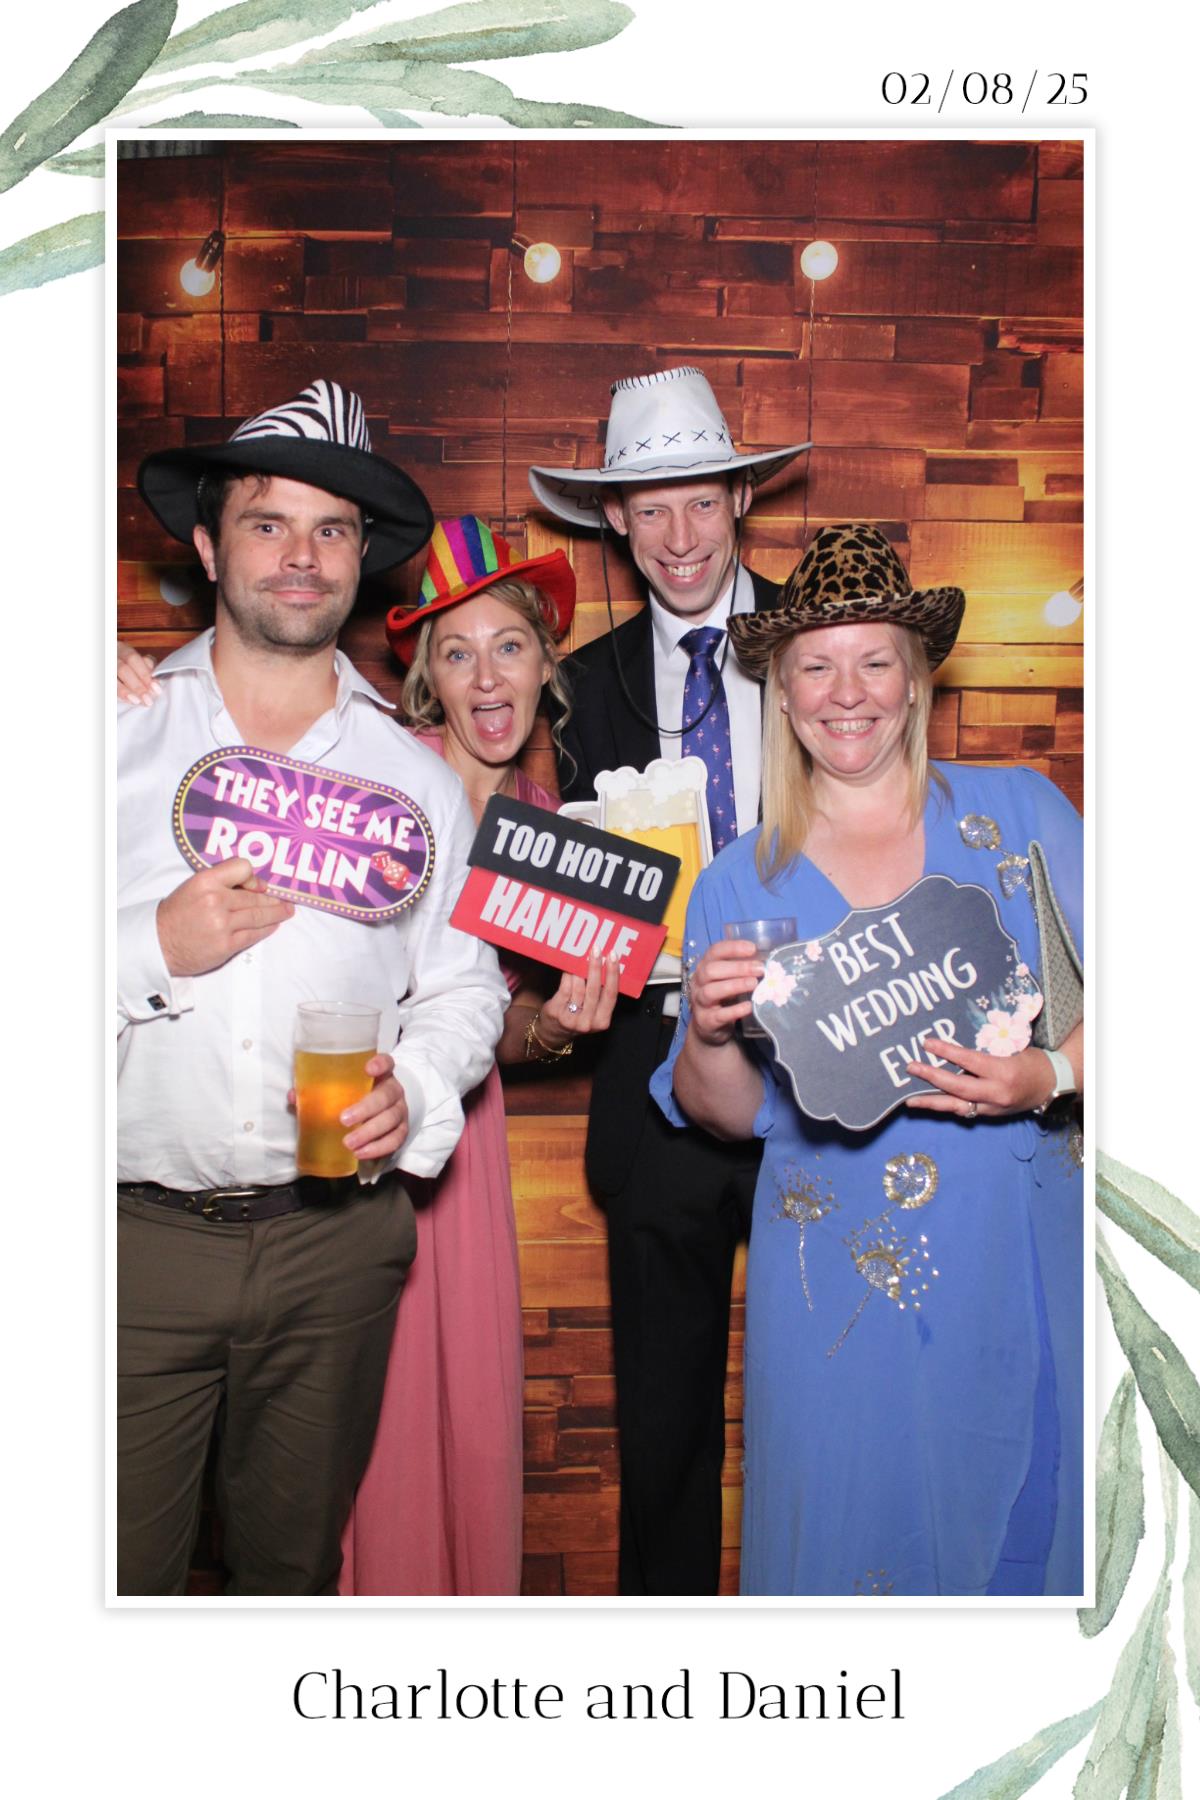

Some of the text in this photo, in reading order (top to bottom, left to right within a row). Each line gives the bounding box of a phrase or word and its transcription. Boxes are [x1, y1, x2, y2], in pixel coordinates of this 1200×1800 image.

[212, 766, 415, 852] THEY SEE ME
[204, 816, 371, 894] ROLLIN
[492, 817, 664, 902] TOO HOT TO
[479, 875, 640, 975] HANDLE
[827, 912, 914, 986] BEST
[815, 947, 977, 1052] WEDDING
[879, 1018, 964, 1088] EVER
